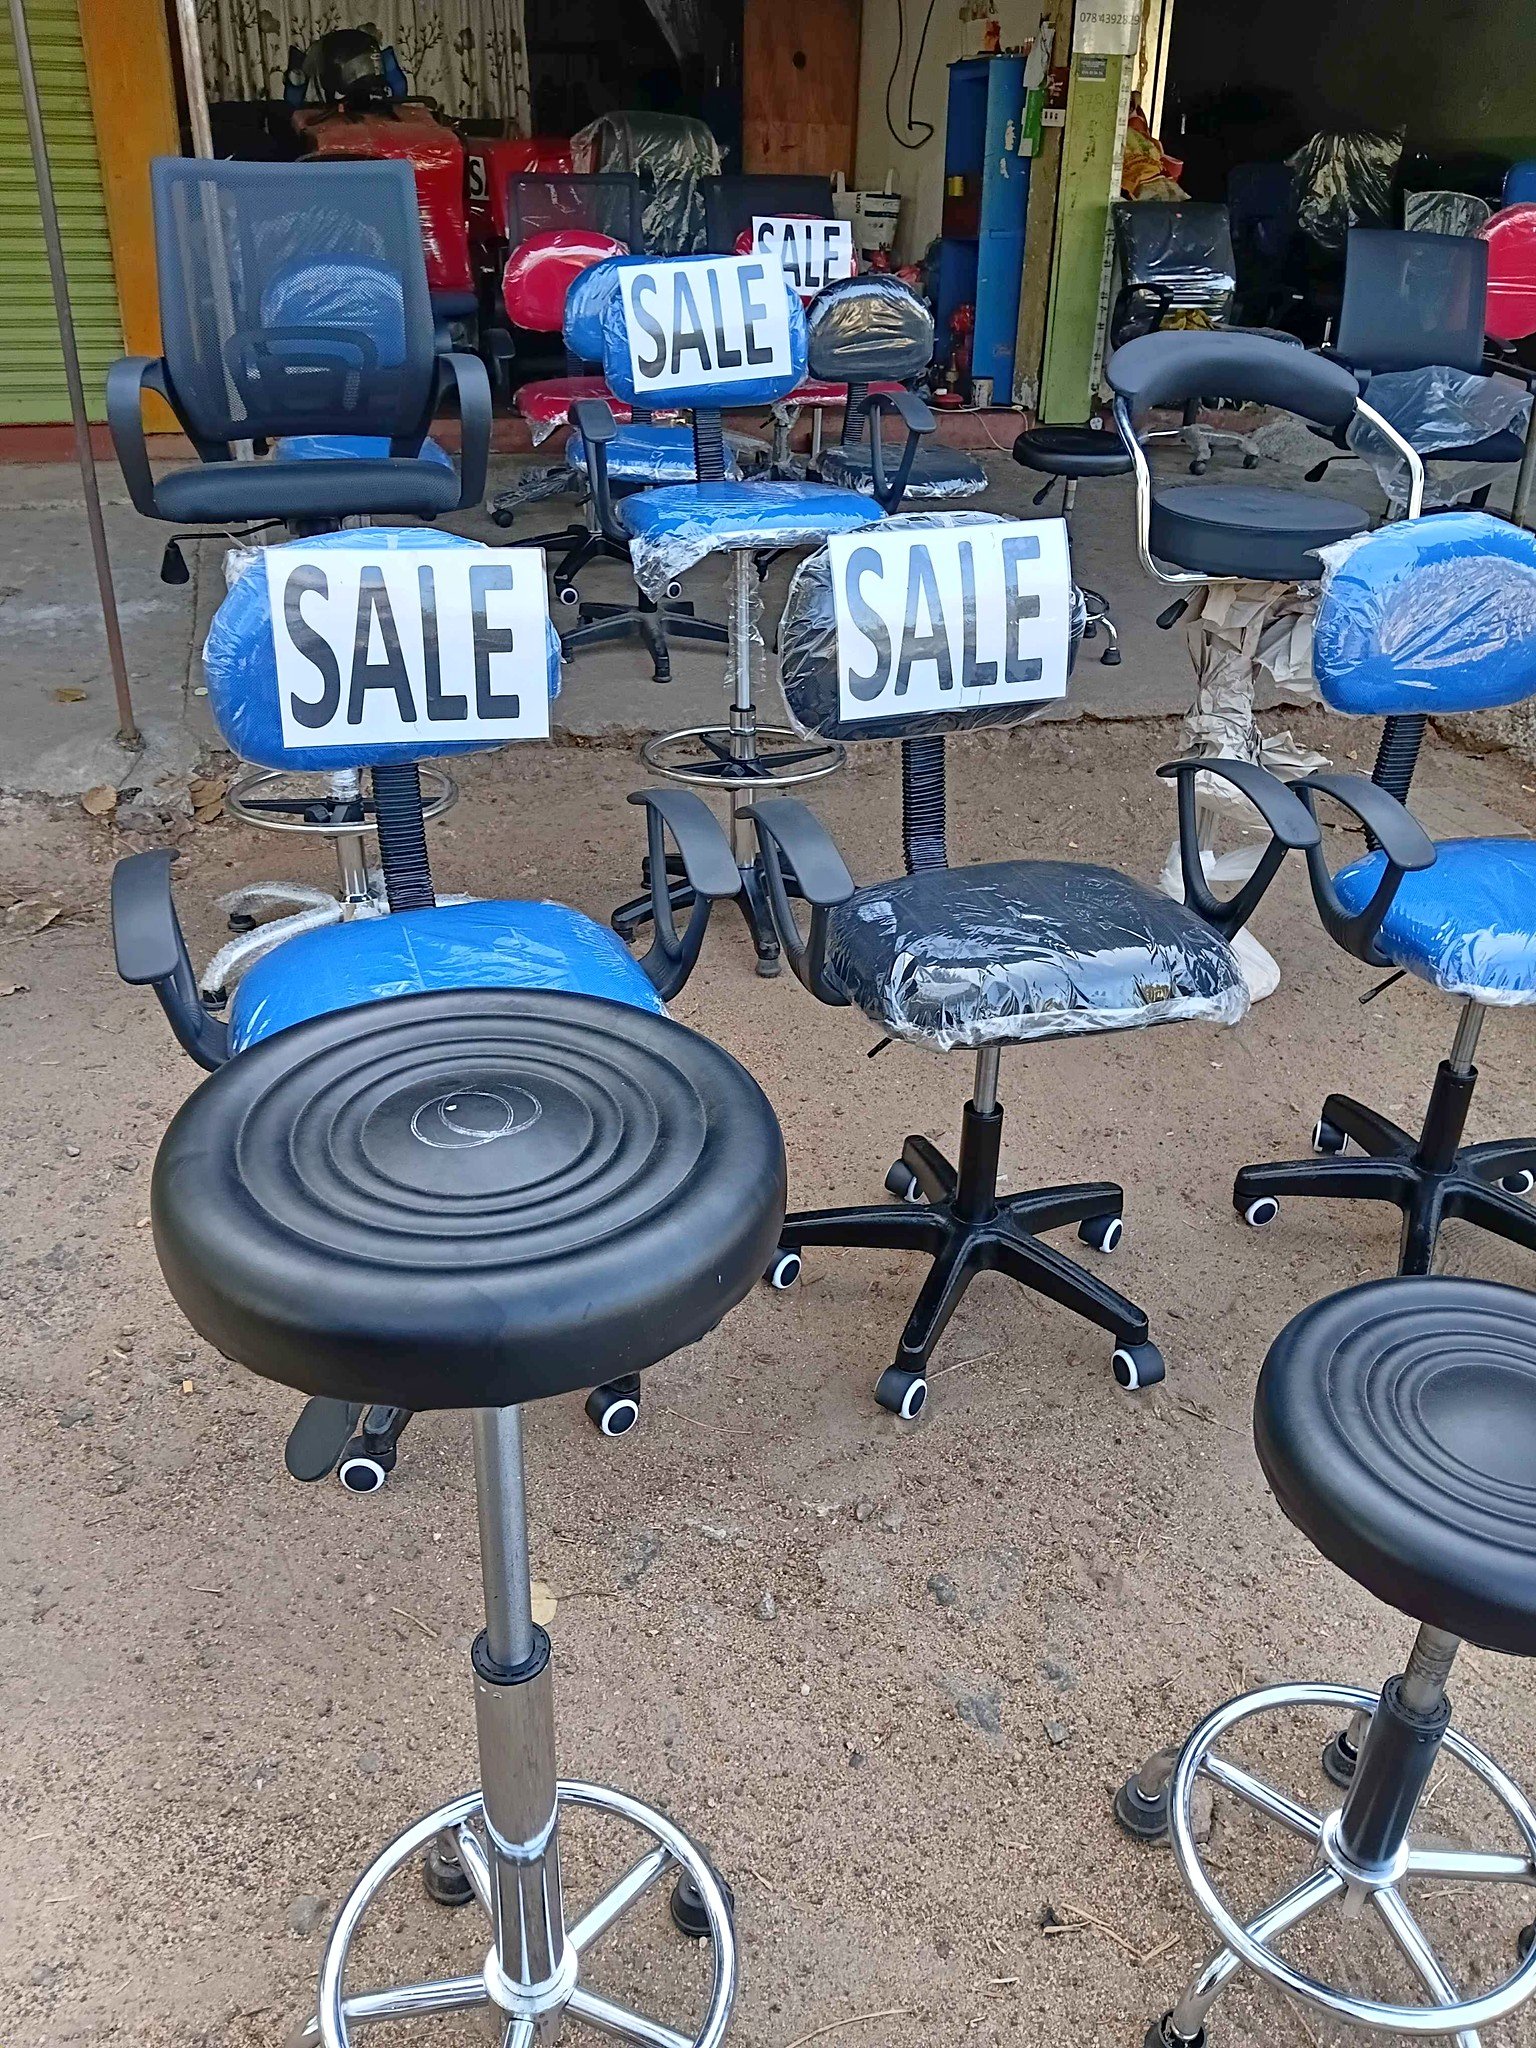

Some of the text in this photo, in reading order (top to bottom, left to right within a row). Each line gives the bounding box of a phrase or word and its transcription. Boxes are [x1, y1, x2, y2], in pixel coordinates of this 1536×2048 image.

[632, 264, 772, 378] SALE
[283, 564, 521, 729] SALE
[847, 536, 1043, 702] SALE
